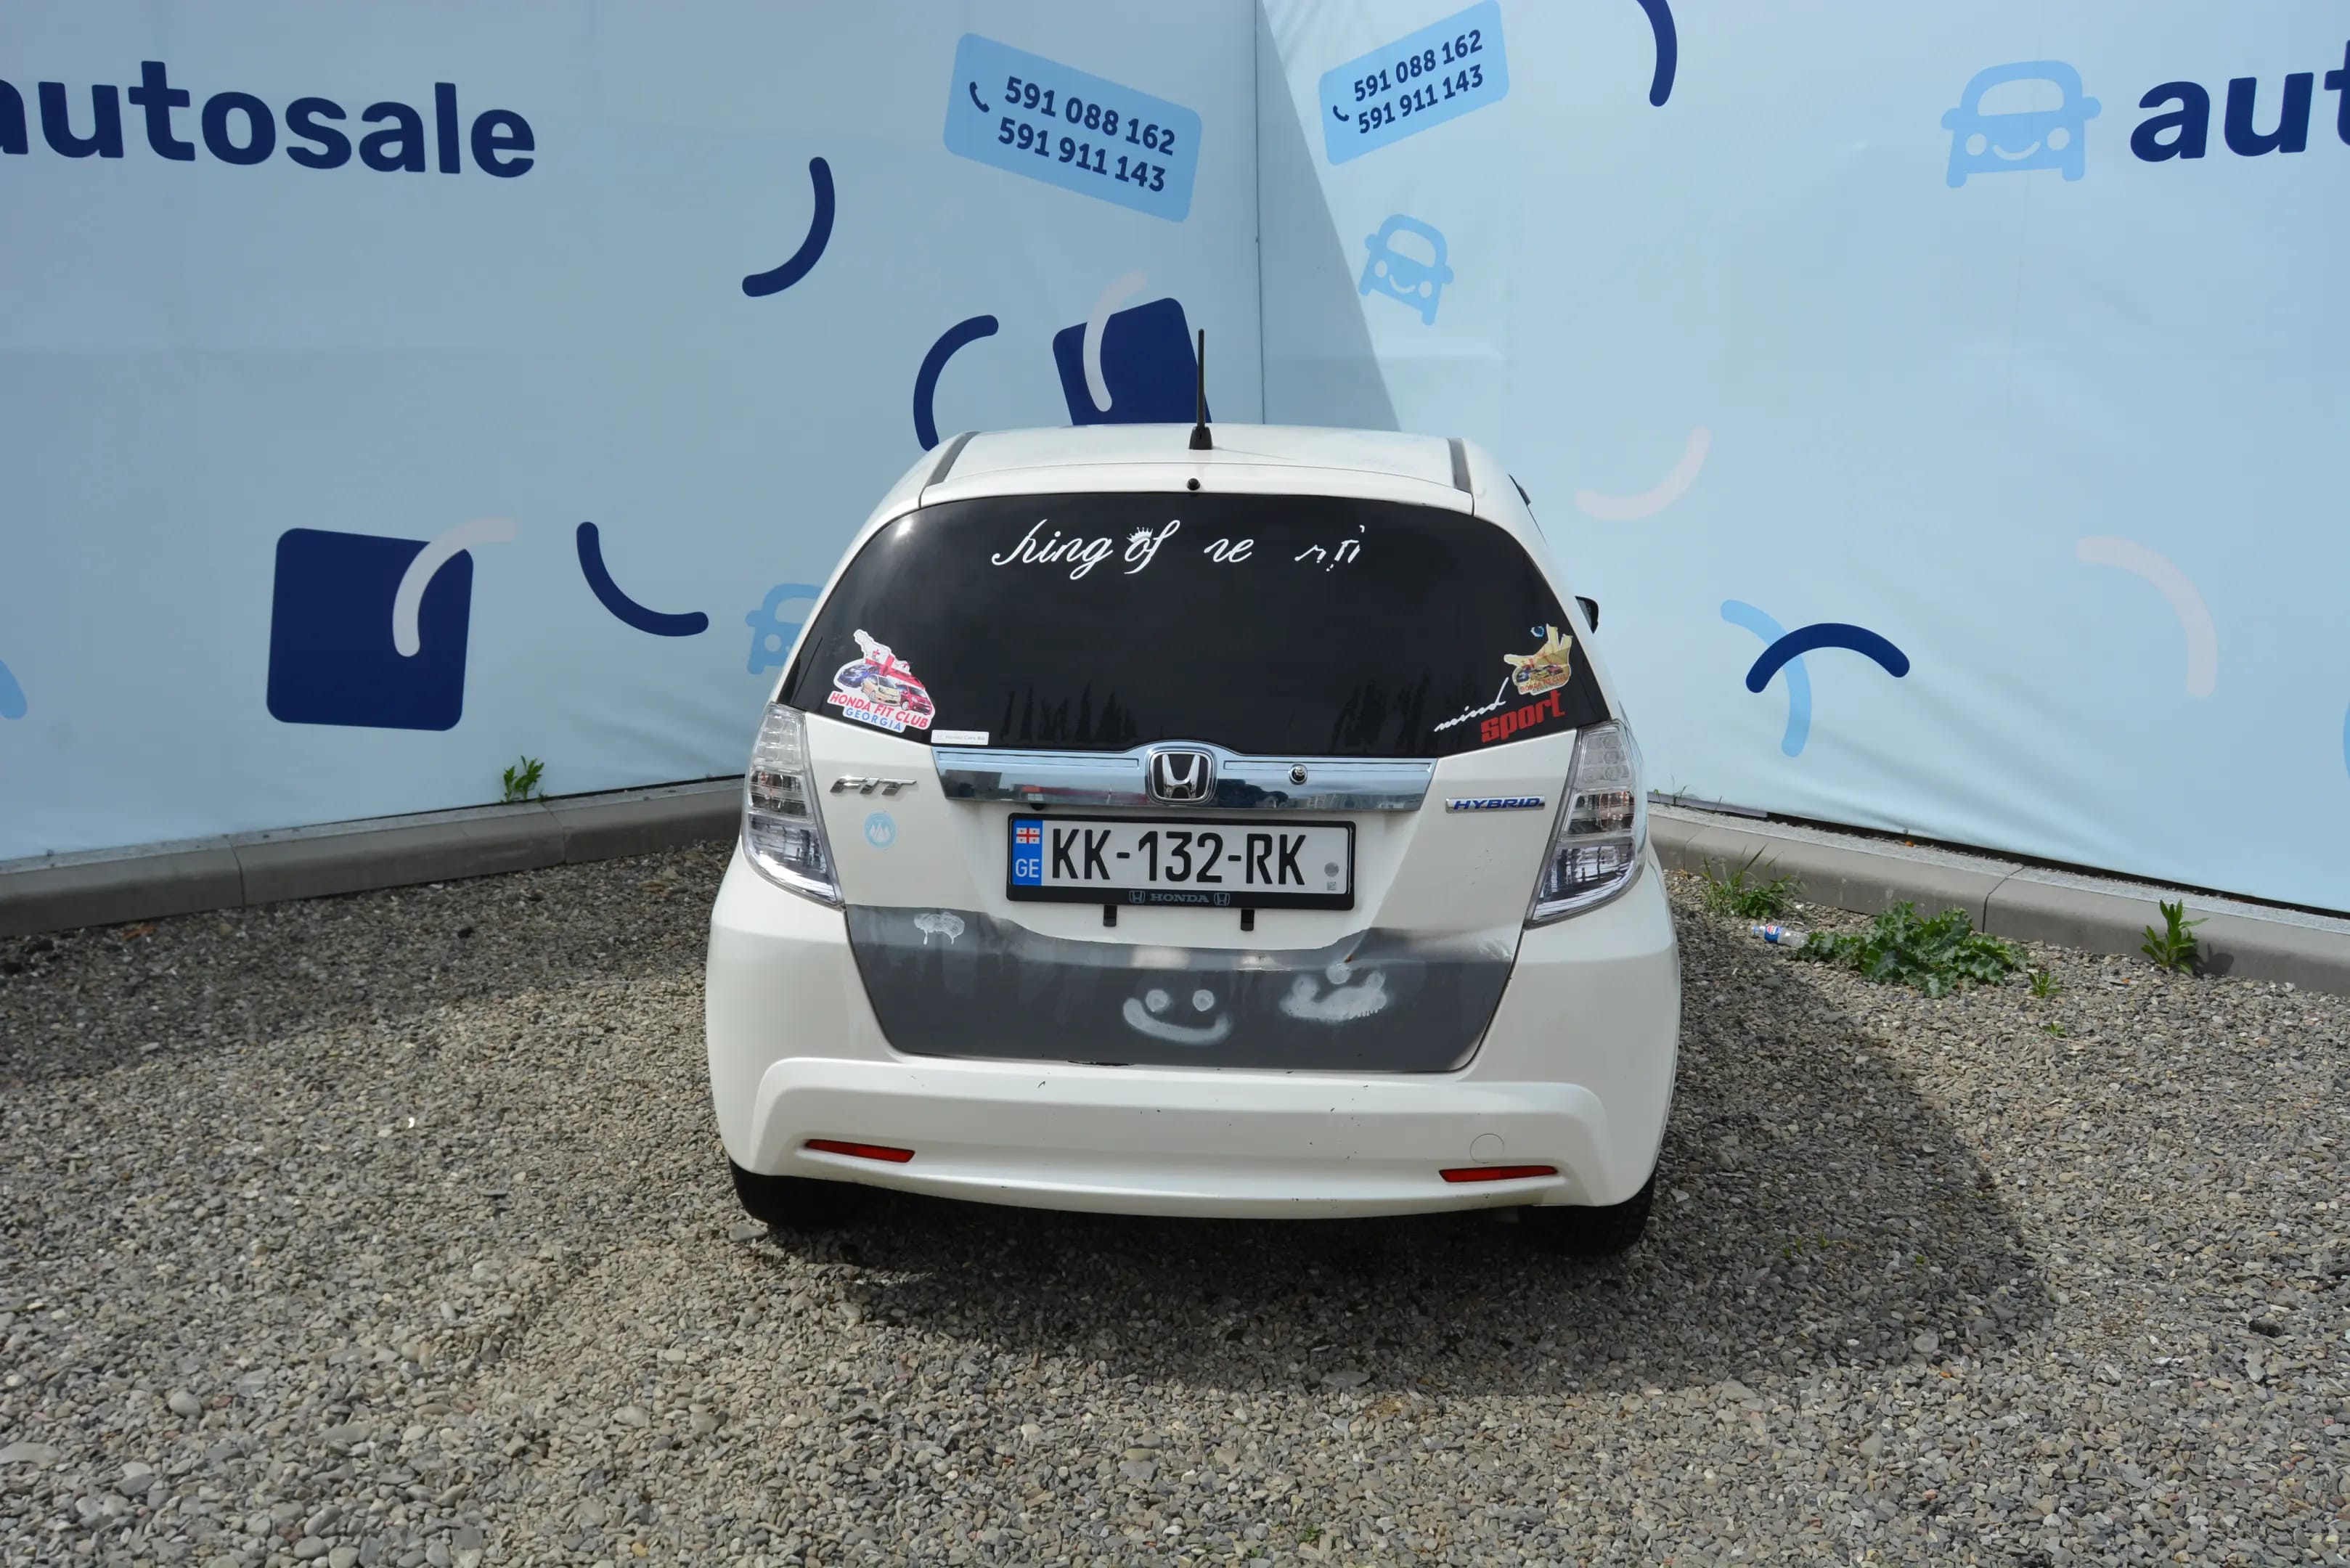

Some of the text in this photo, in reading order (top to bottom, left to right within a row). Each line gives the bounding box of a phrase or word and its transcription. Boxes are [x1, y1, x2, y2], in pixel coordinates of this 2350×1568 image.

[1354, 29, 1482, 102] 591 088 162
[1005, 75, 1175, 156] 591 088 162
[1358, 64, 1483, 134] 591 911 143
[998, 116, 1165, 192] 591 911 143
[830, 693, 929, 728] HONDA FIT CLUB
[846, 707, 901, 731] GEORGIA
[1480, 690, 1565, 743] sport
[830, 775, 917, 796] FIT
[1453, 797, 1541, 810] HYBRID
[1015, 858, 1040, 878] GE
[1051, 828, 1307, 886] KK-132-RK
[1150, 894, 1209, 903] HONDA
